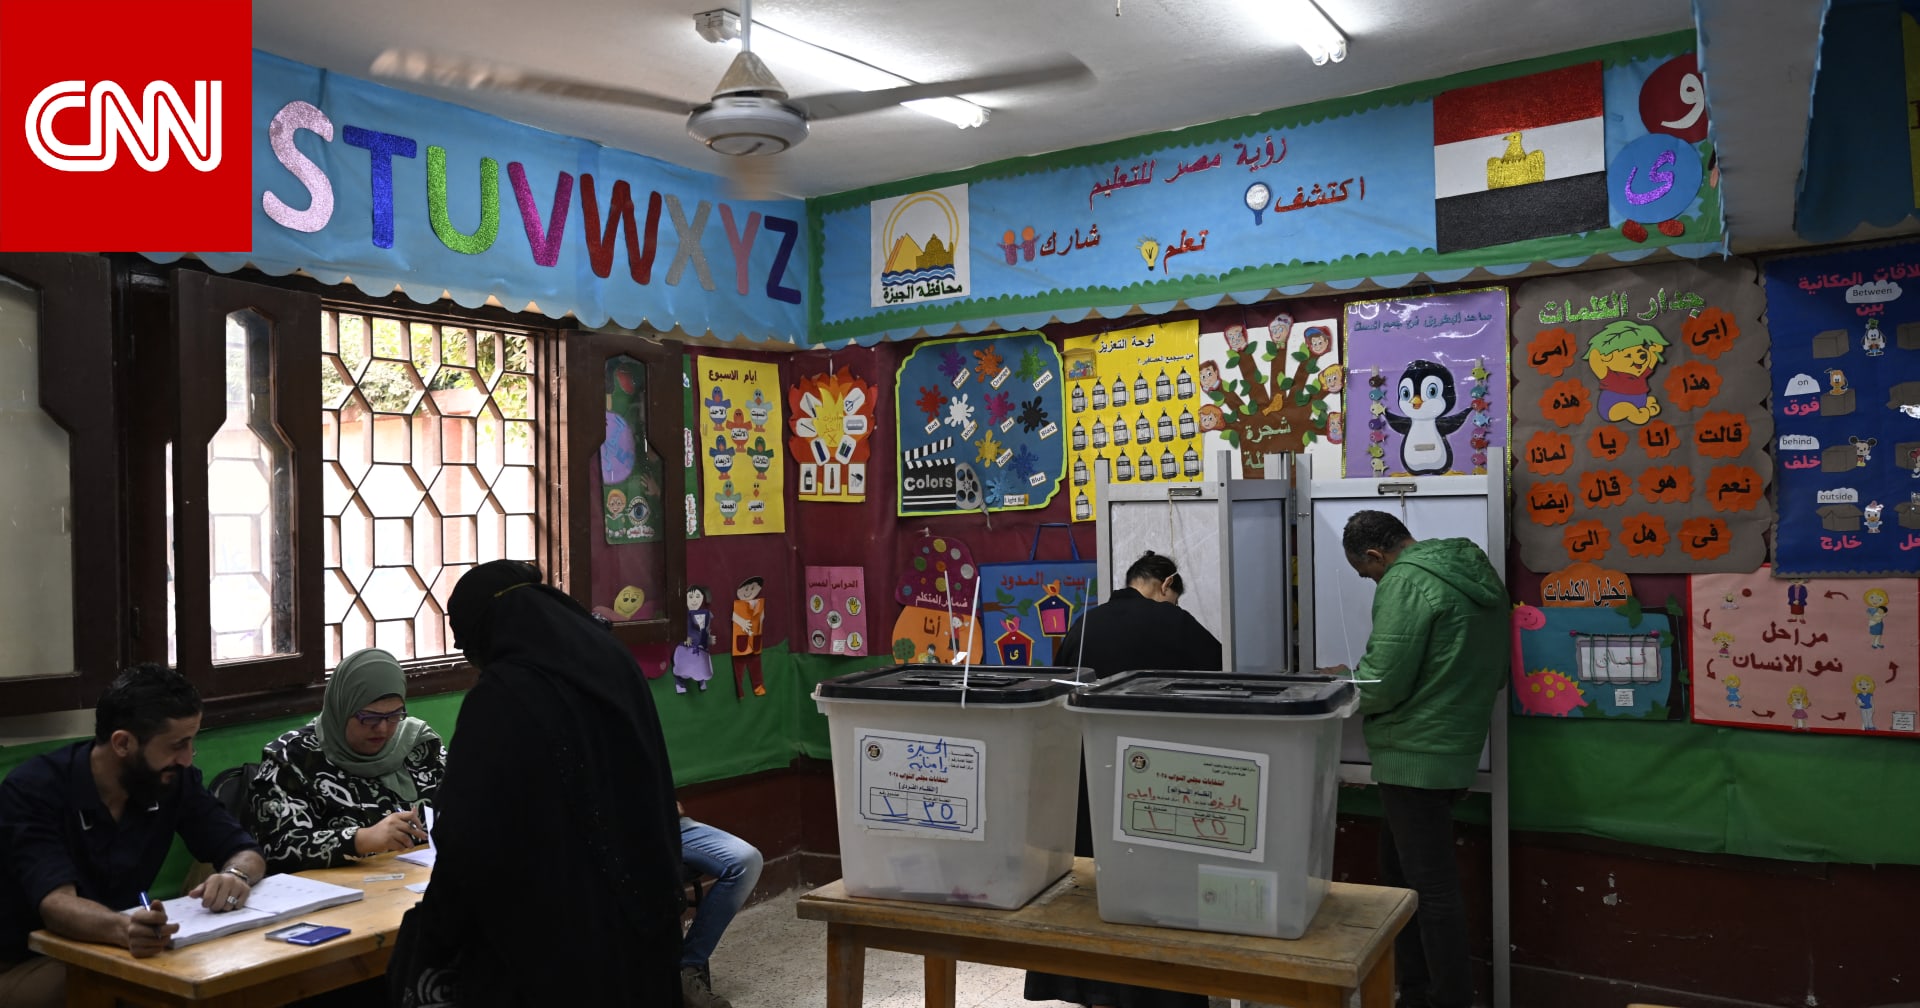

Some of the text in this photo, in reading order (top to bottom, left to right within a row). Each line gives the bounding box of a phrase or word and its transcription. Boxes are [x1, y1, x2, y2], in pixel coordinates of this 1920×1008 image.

[1661, 72, 1705, 130] و
[1089, 136, 1287, 212] رؤية مصر للتعليم
[1274, 176, 1366, 212] اكتشف
[1039, 224, 1100, 257] شارك
[1163, 229, 1209, 275] تعلم
[883, 280, 963, 304] محافظة الجيزة
[1798, 271, 1863, 295] المكانية
[1852, 287, 1892, 297] Between
[1538, 287, 1705, 324] جدار الكلمات
[1692, 317, 1728, 346] ابى
[1098, 334, 1155, 353] لوحة التعزيز
[1532, 338, 1569, 365] امى
[708, 369, 757, 385] ايام الاسبوع
[954, 369, 969, 388] Purple
[992, 367, 1009, 388] Orange
[1034, 373, 1051, 389] Green
[1682, 375, 1710, 393] هذا
[1552, 393, 1580, 410] هذه
[1783, 396, 1820, 416] فوق
[927, 421, 938, 432] Red
[1002, 419, 1013, 431] Pink
[1040, 424, 1056, 437] Black
[1245, 416, 1291, 443] شجرة
[1698, 423, 1742, 443] قالت
[1598, 431, 1616, 454] يا
[1646, 427, 1669, 447] انا
[1782, 437, 1812, 445] behind
[1531, 443, 1566, 463] لماذا
[1784, 454, 1821, 469] خلف
[1032, 474, 1044, 485] Blue
[1588, 475, 1621, 501] قال
[1651, 475, 1676, 494] هو
[1718, 478, 1751, 501] نعم
[1531, 493, 1569, 511] ايضا
[1820, 491, 1853, 500] outside
[1572, 529, 1599, 553] الى
[1633, 523, 1657, 544] هل
[1692, 523, 1719, 548] فى
[1820, 535, 1862, 551] خارج
[831, 579, 858, 590] الحواس
[1063, 575, 1085, 590] بيت
[1544, 576, 1627, 607] تحليل الكلمات
[915, 591, 941, 606] المتكلم
[923, 615, 941, 637] أنا
[1762, 621, 1828, 647] مراحل
[1732, 653, 1843, 676] نمو الانسان
